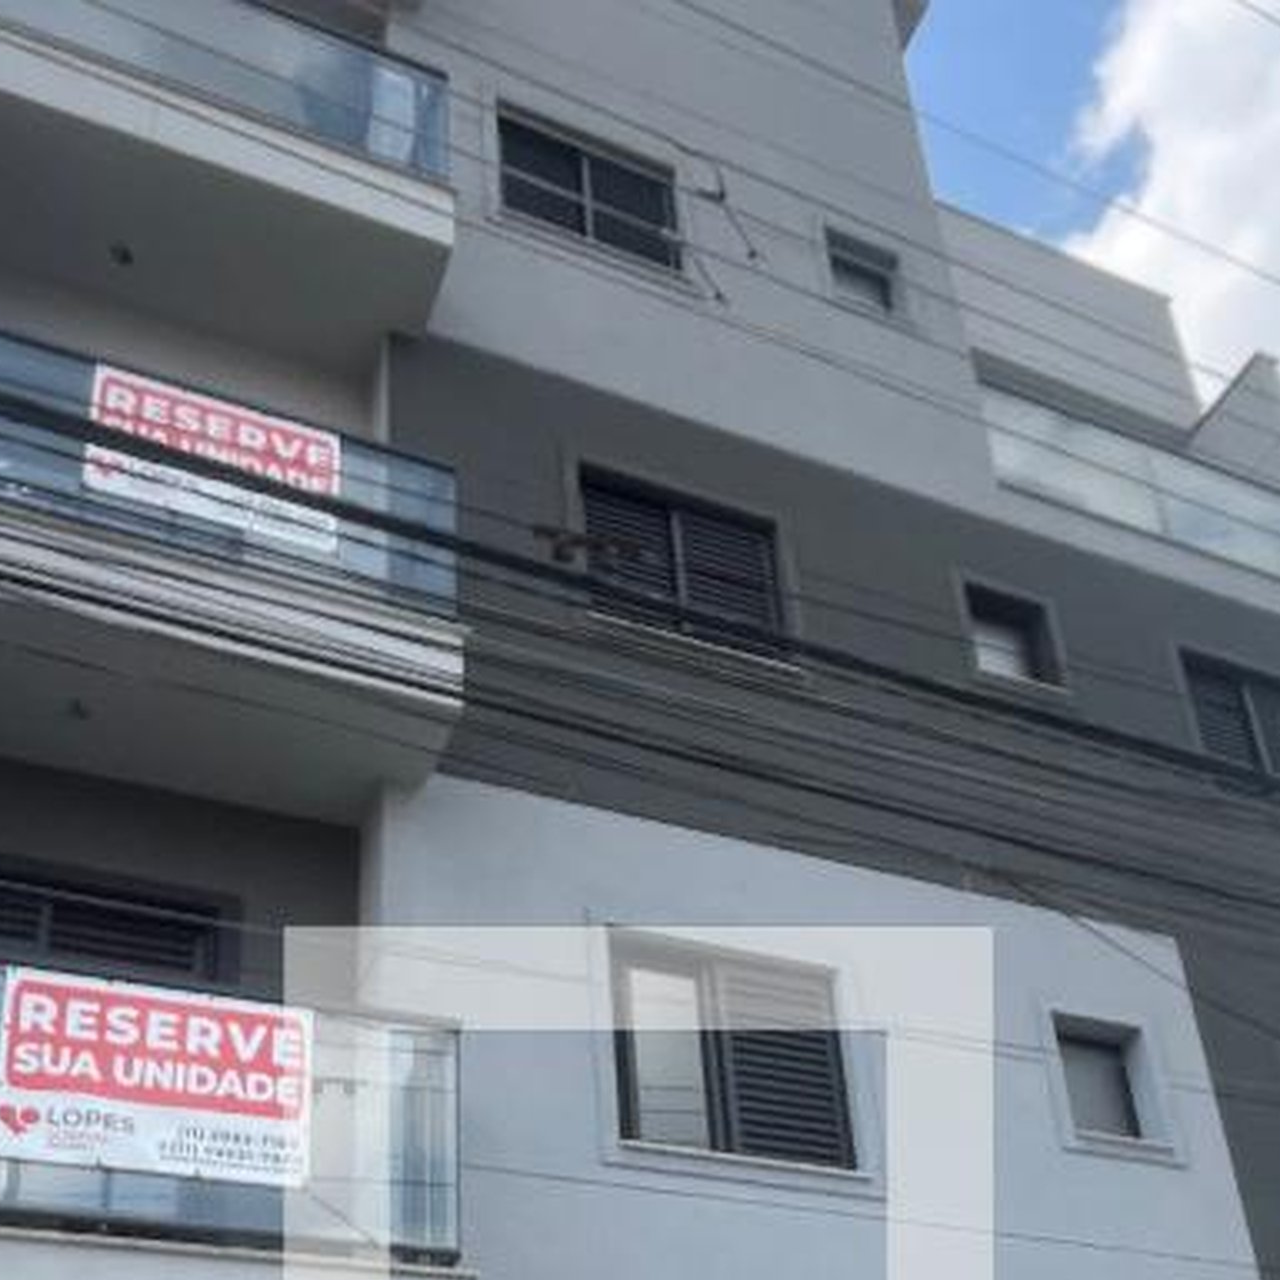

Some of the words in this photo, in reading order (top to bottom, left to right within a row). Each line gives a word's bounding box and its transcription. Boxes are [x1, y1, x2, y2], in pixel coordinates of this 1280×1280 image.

[102, 381, 332, 466] RESERVE
[18, 991, 302, 1068] RESERVE
[12, 1042, 102, 1082] SUA
[113, 1055, 300, 1104] UNIDADE
[46, 1107, 135, 1134] LOPES
